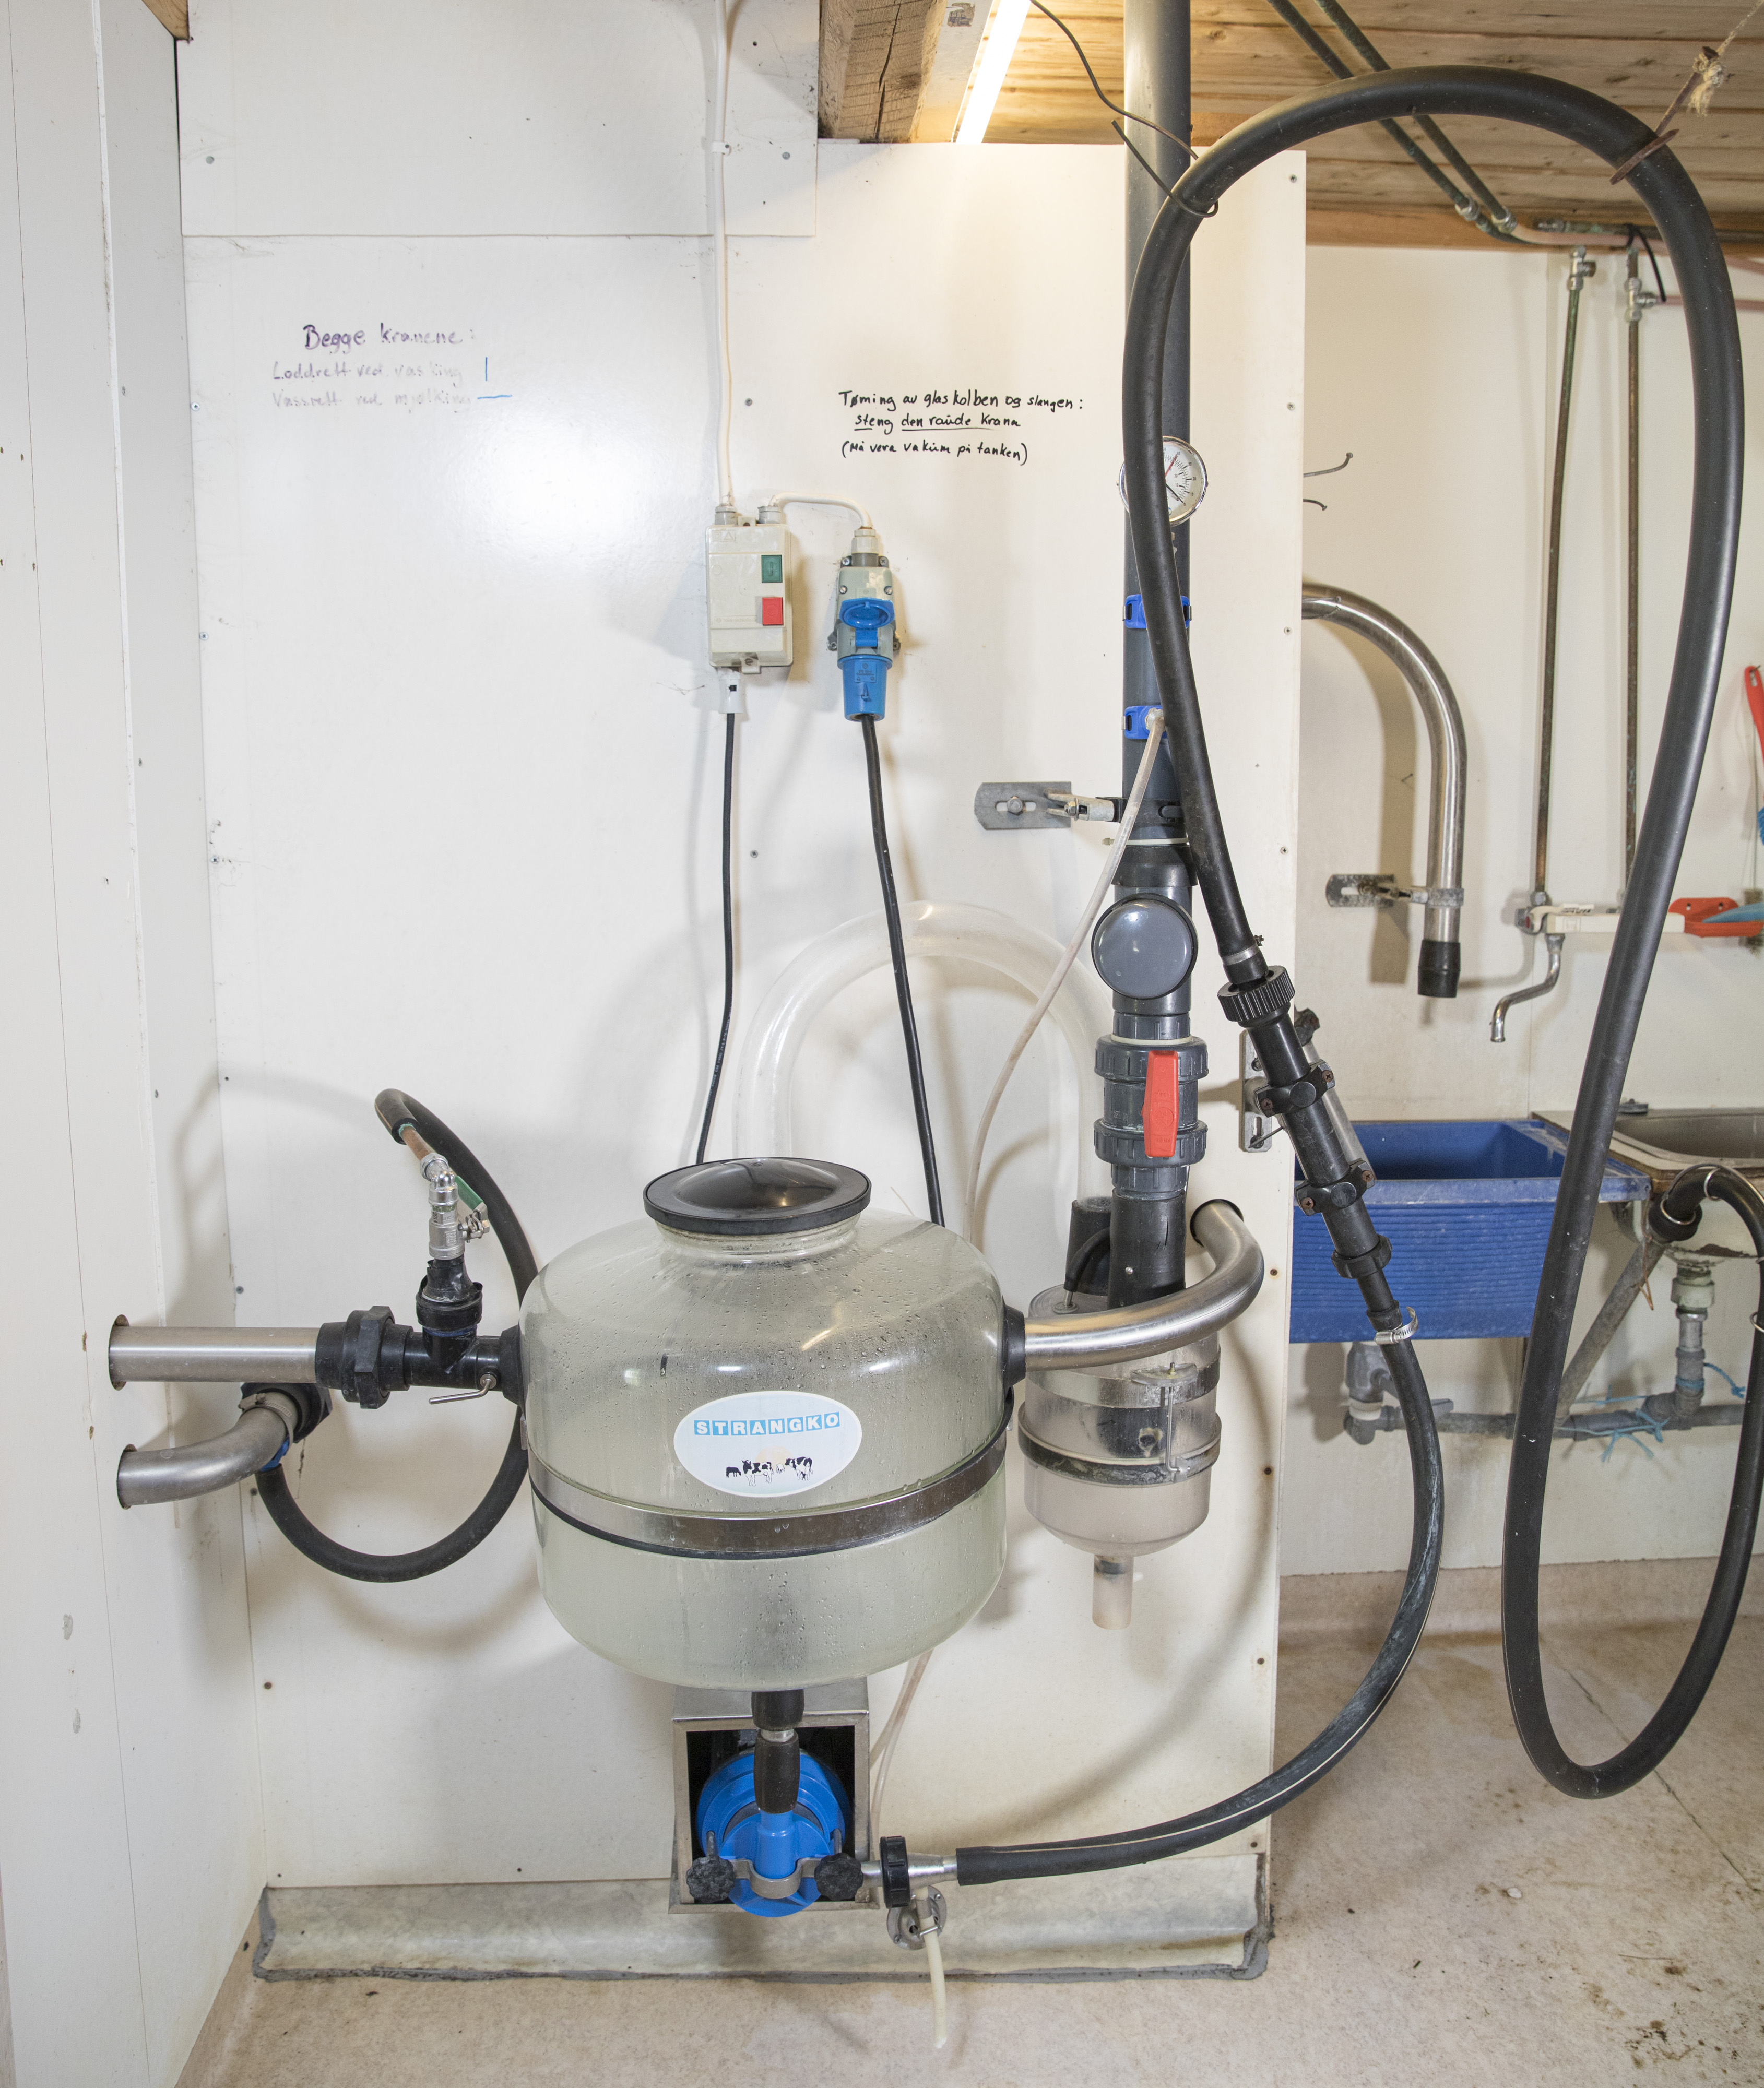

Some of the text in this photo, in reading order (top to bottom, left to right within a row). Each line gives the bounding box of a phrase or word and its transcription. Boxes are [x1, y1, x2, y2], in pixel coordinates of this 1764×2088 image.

[303, 323, 366, 355] Begge
[273, 361, 349, 382] Loddrett
[838, 390, 896, 412] Tøming
[903, 395, 918, 404] av
[1005, 396, 1022, 409] og
[855, 413, 894, 435] steng
[901, 412, 923, 428] den
[869, 444, 897, 453] vera
[956, 444, 971, 458] på
[977, 441, 1028, 466] tanken)
[694, 1412, 840, 1436] STRANGKO
